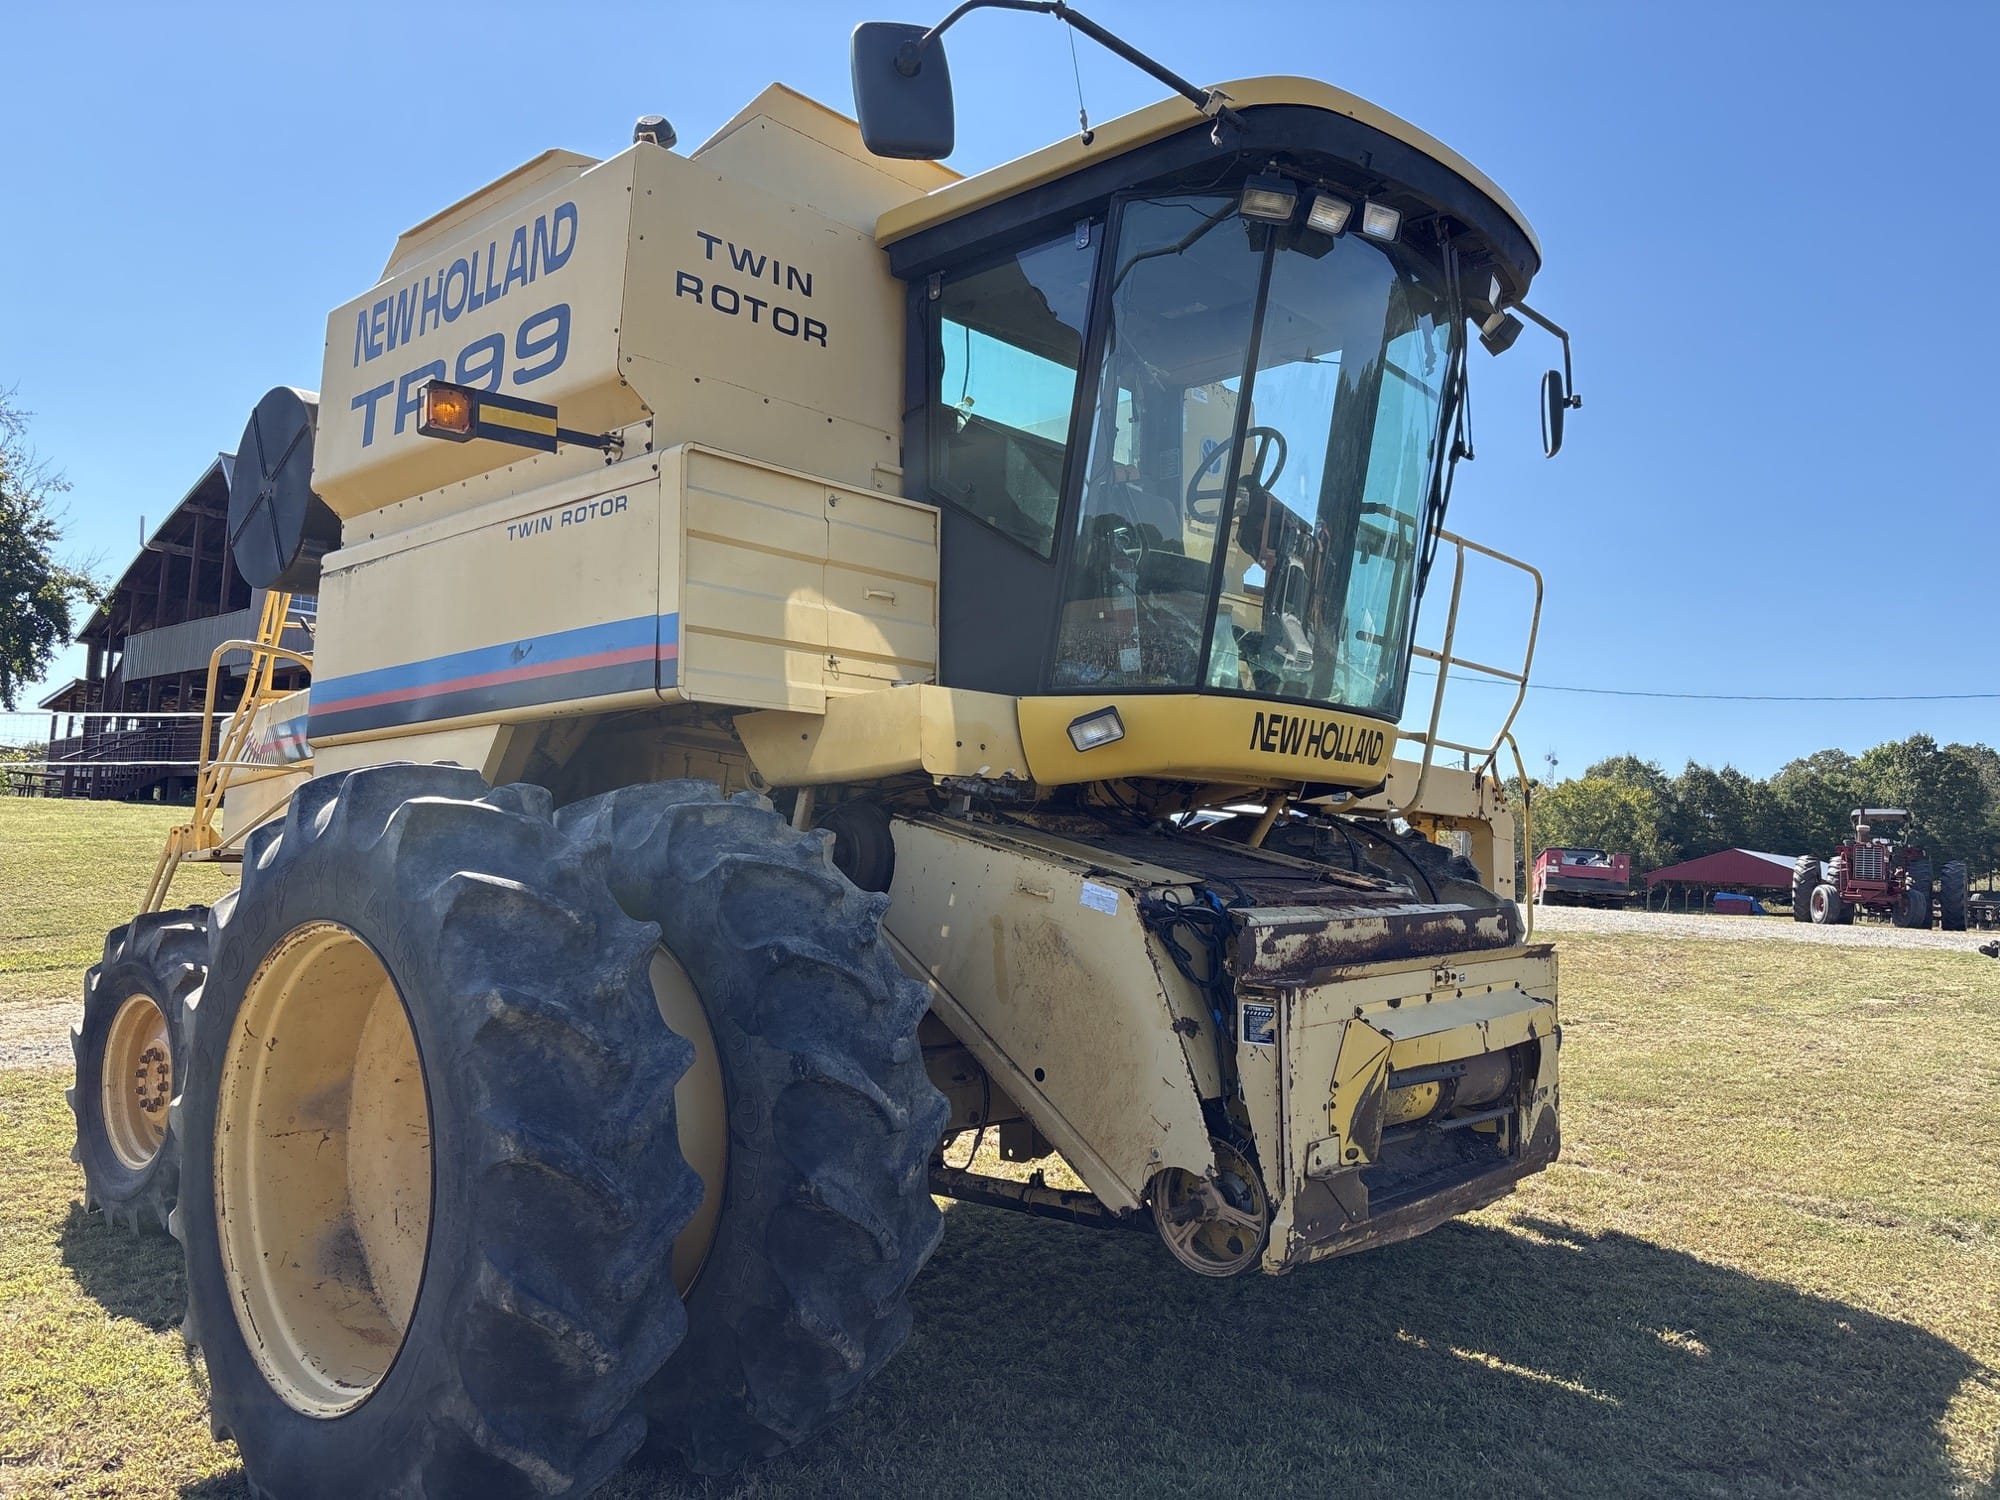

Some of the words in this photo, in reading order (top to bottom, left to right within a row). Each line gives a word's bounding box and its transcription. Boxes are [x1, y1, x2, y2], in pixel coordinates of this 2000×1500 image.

[353, 282, 419, 369] NEW
[419, 201, 578, 337] HOLLAND
[696, 230, 812, 298] TWIN
[676, 270, 828, 348] ROTOR
[507, 515, 552, 541] TWIN
[561, 495, 628, 528] ROTOR
[1250, 711, 1308, 755] NEW
[1304, 719, 1384, 766] HOLLAND
